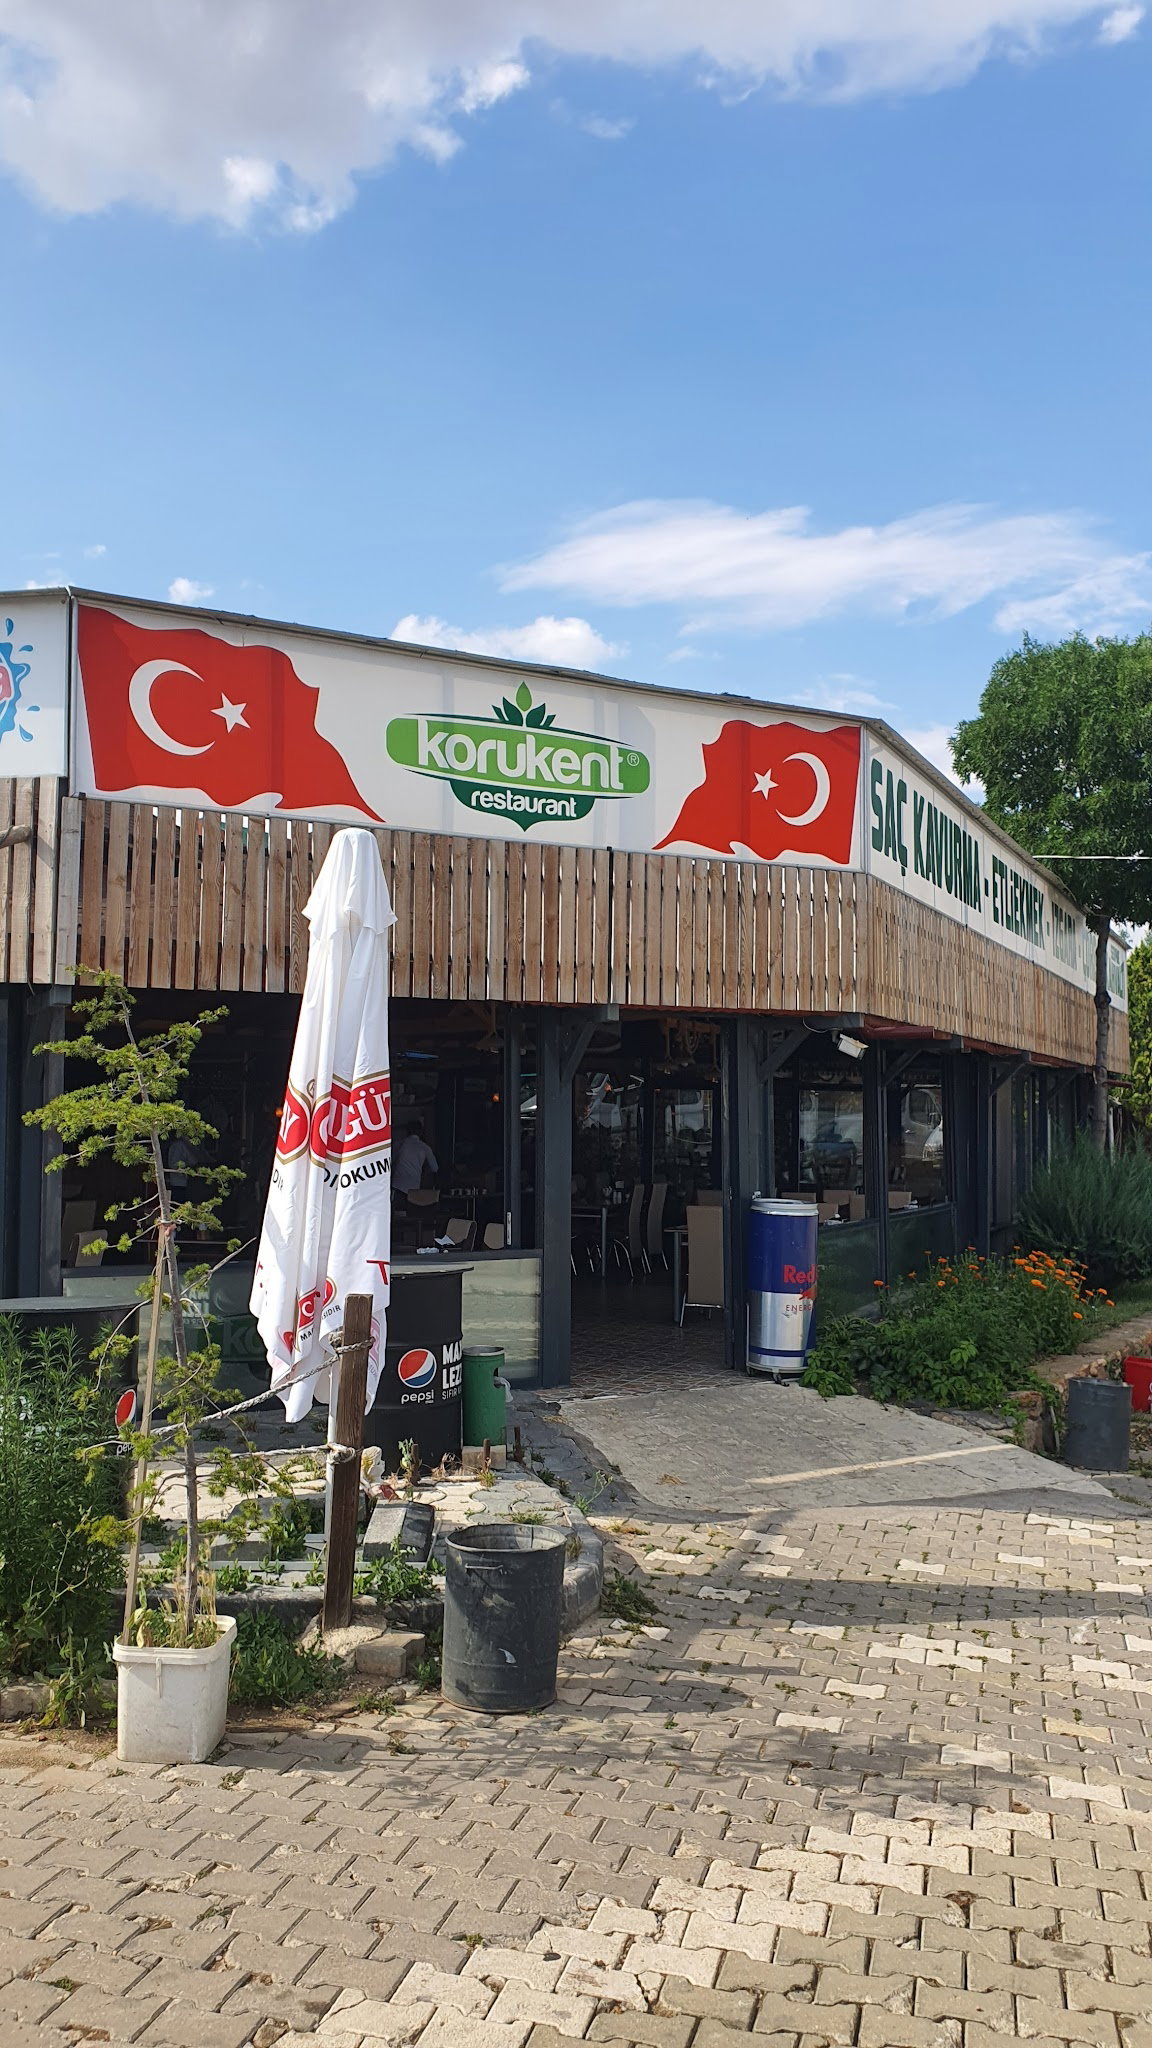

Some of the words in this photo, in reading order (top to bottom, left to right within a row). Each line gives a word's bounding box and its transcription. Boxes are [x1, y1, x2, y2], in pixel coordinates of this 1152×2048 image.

[418, 718, 624, 790] korukent
[471, 790, 577, 817] restaurant
[871, 758, 908, 877] SAÇ
[913, 789, 982, 914] KAVURMA
[783, 1264, 816, 1285] Red
[785, 1304, 813, 1312] ENERG
[401, 1389, 434, 1405] pepsi
